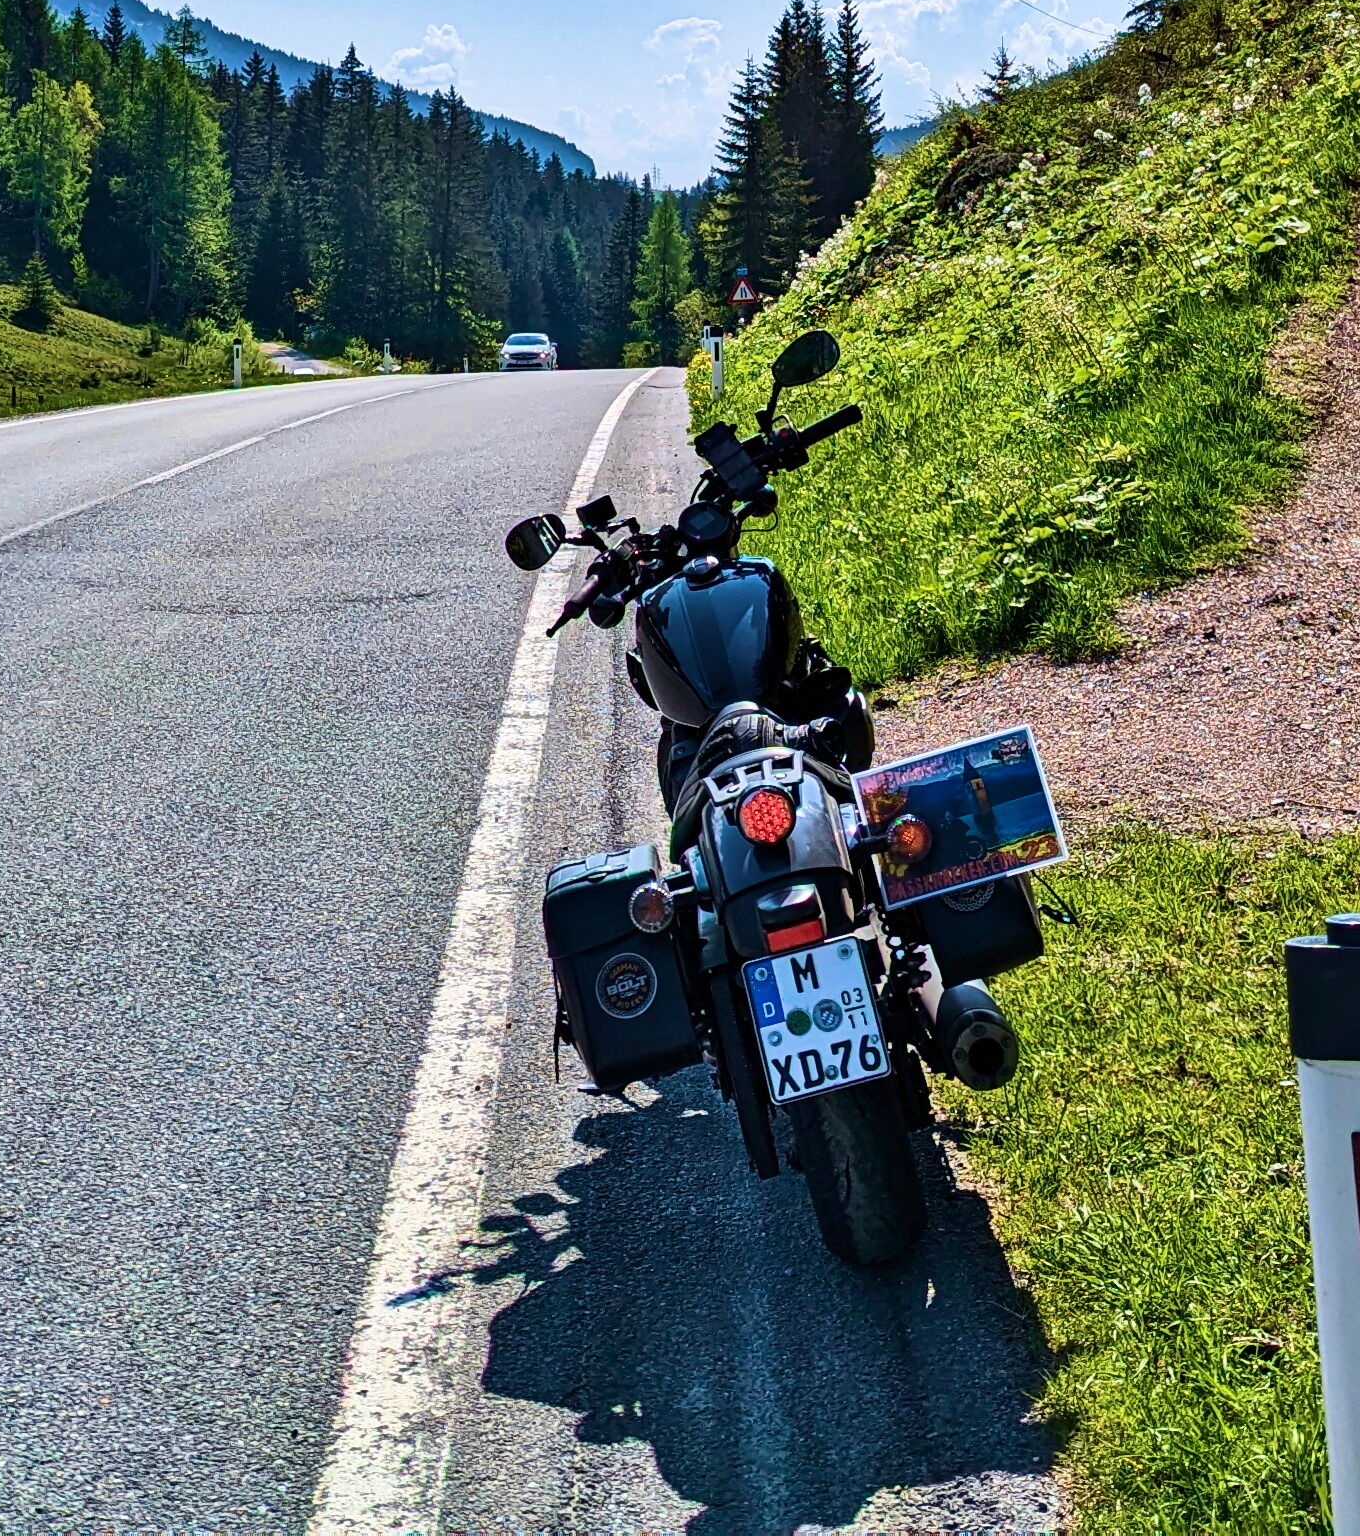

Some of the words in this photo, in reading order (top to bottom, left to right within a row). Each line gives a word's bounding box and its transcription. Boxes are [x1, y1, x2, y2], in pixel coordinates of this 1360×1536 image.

[790, 953, 820, 993] M
[606, 975, 647, 996] BOLT
[840, 988, 863, 1005] 03
[762, 1002, 776, 1018] D
[848, 1012, 868, 1029] 11
